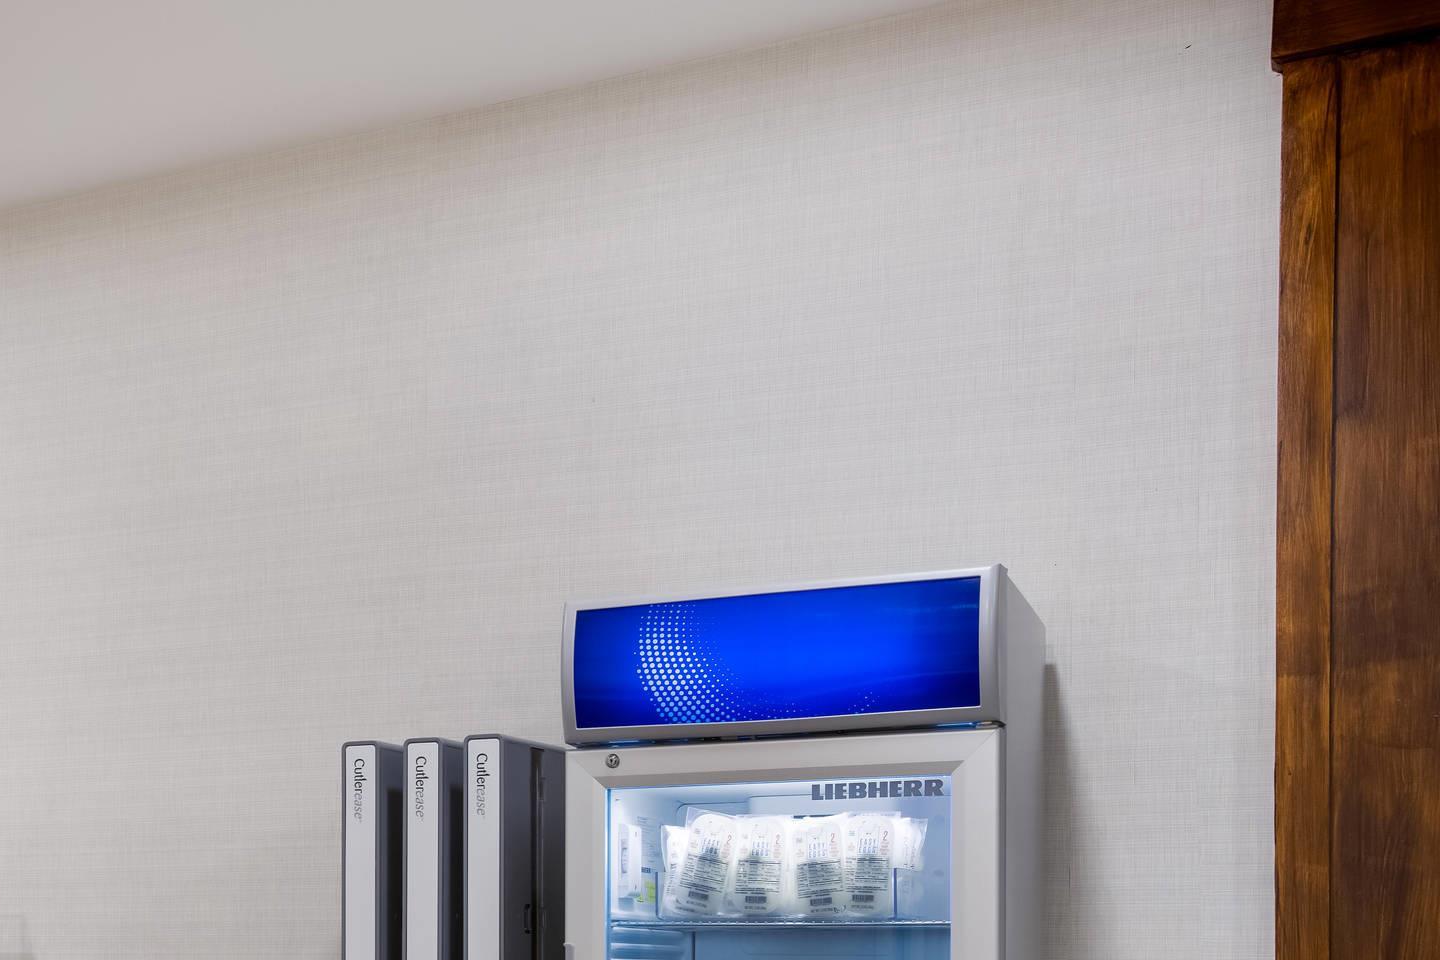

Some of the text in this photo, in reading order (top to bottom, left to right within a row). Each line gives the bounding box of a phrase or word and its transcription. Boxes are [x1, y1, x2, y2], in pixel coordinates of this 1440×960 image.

[354, 758, 367, 819] Cutlerease
[415, 756, 429, 818] Cutlerease
[476, 753, 490, 816] Cutlerease
[811, 779, 944, 800] LIEBHERR
